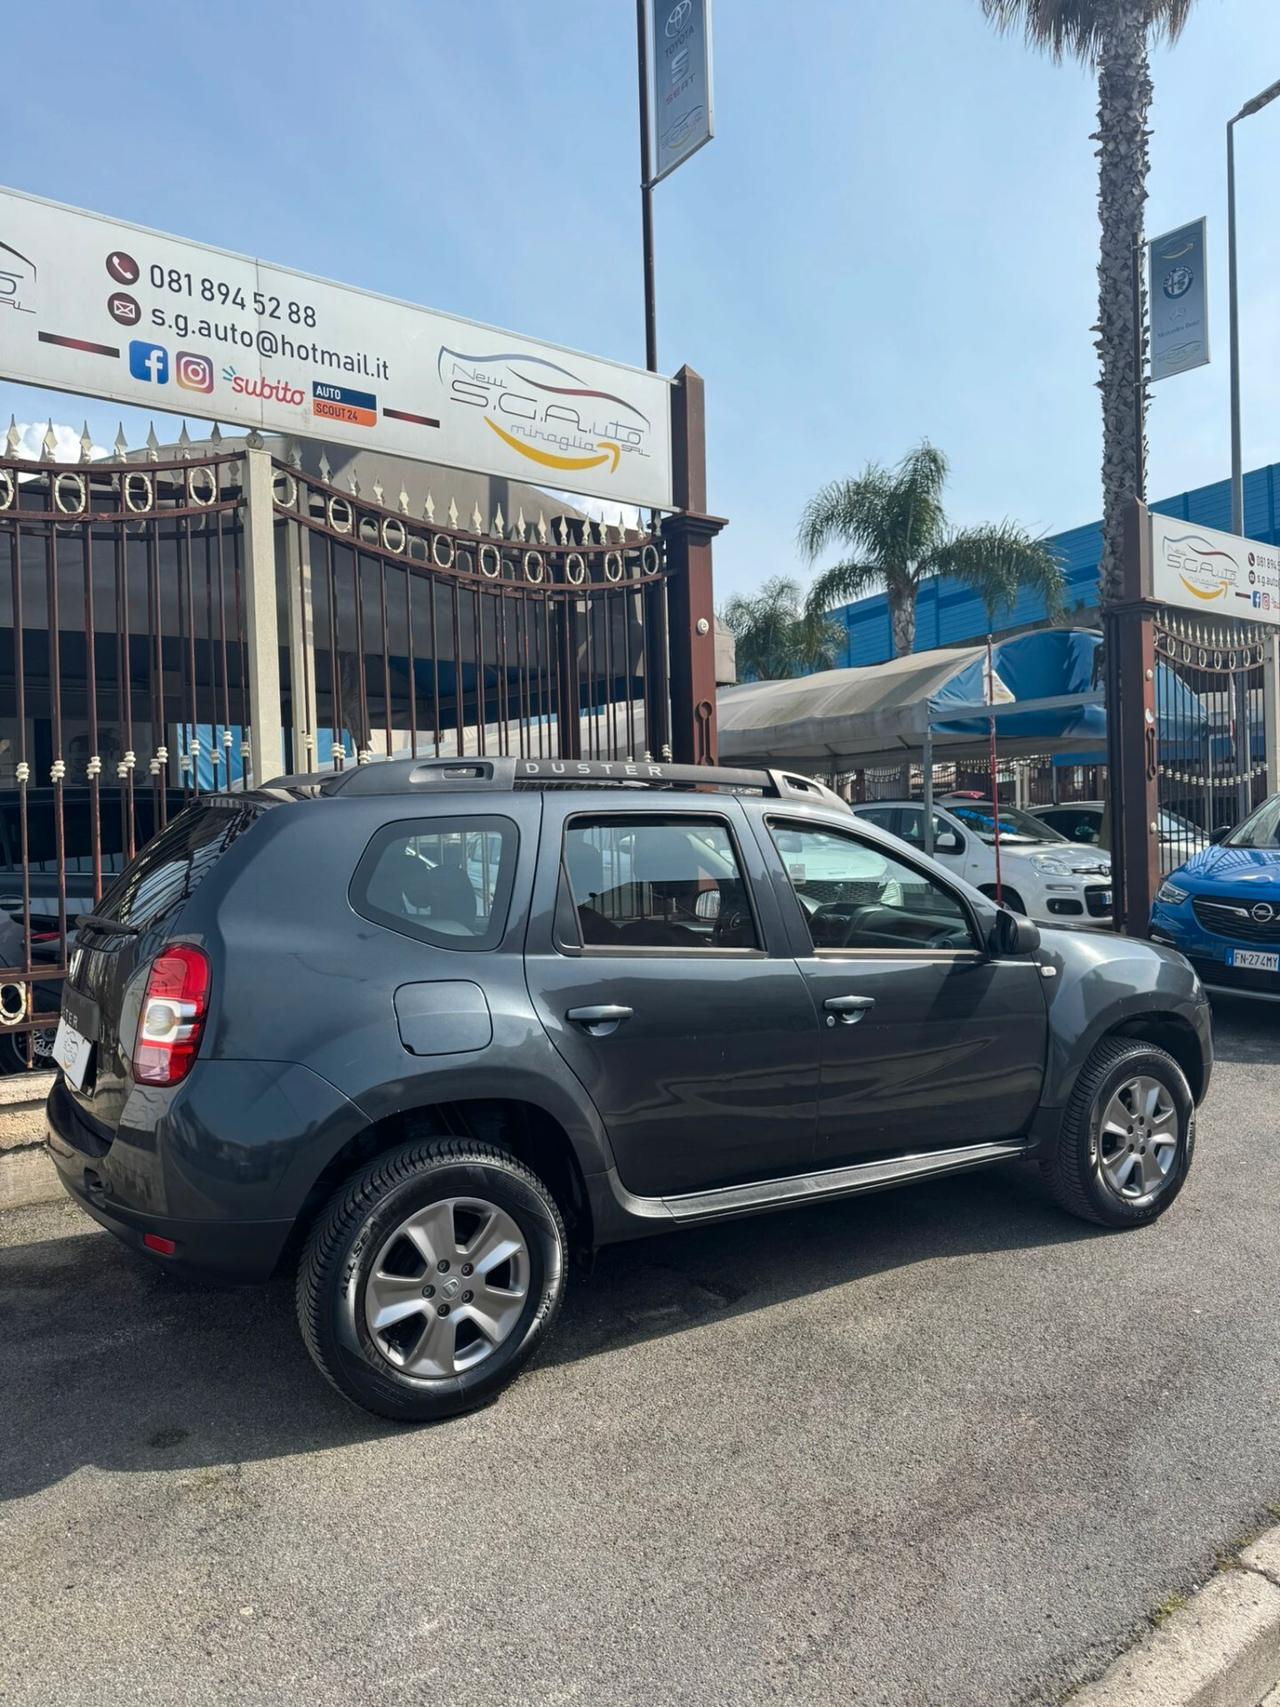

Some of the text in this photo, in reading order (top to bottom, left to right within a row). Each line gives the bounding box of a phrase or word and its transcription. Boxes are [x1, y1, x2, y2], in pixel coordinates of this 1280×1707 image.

[150, 264, 317, 329] 081 894 52 88
[151, 308, 390, 381] s.g.auto@hotmail.it
[231, 376, 306, 407] subito
[315, 384, 342, 401] AUTO
[315, 402, 359, 421] SCOUT 24
[525, 762, 663, 777] DUSTER
